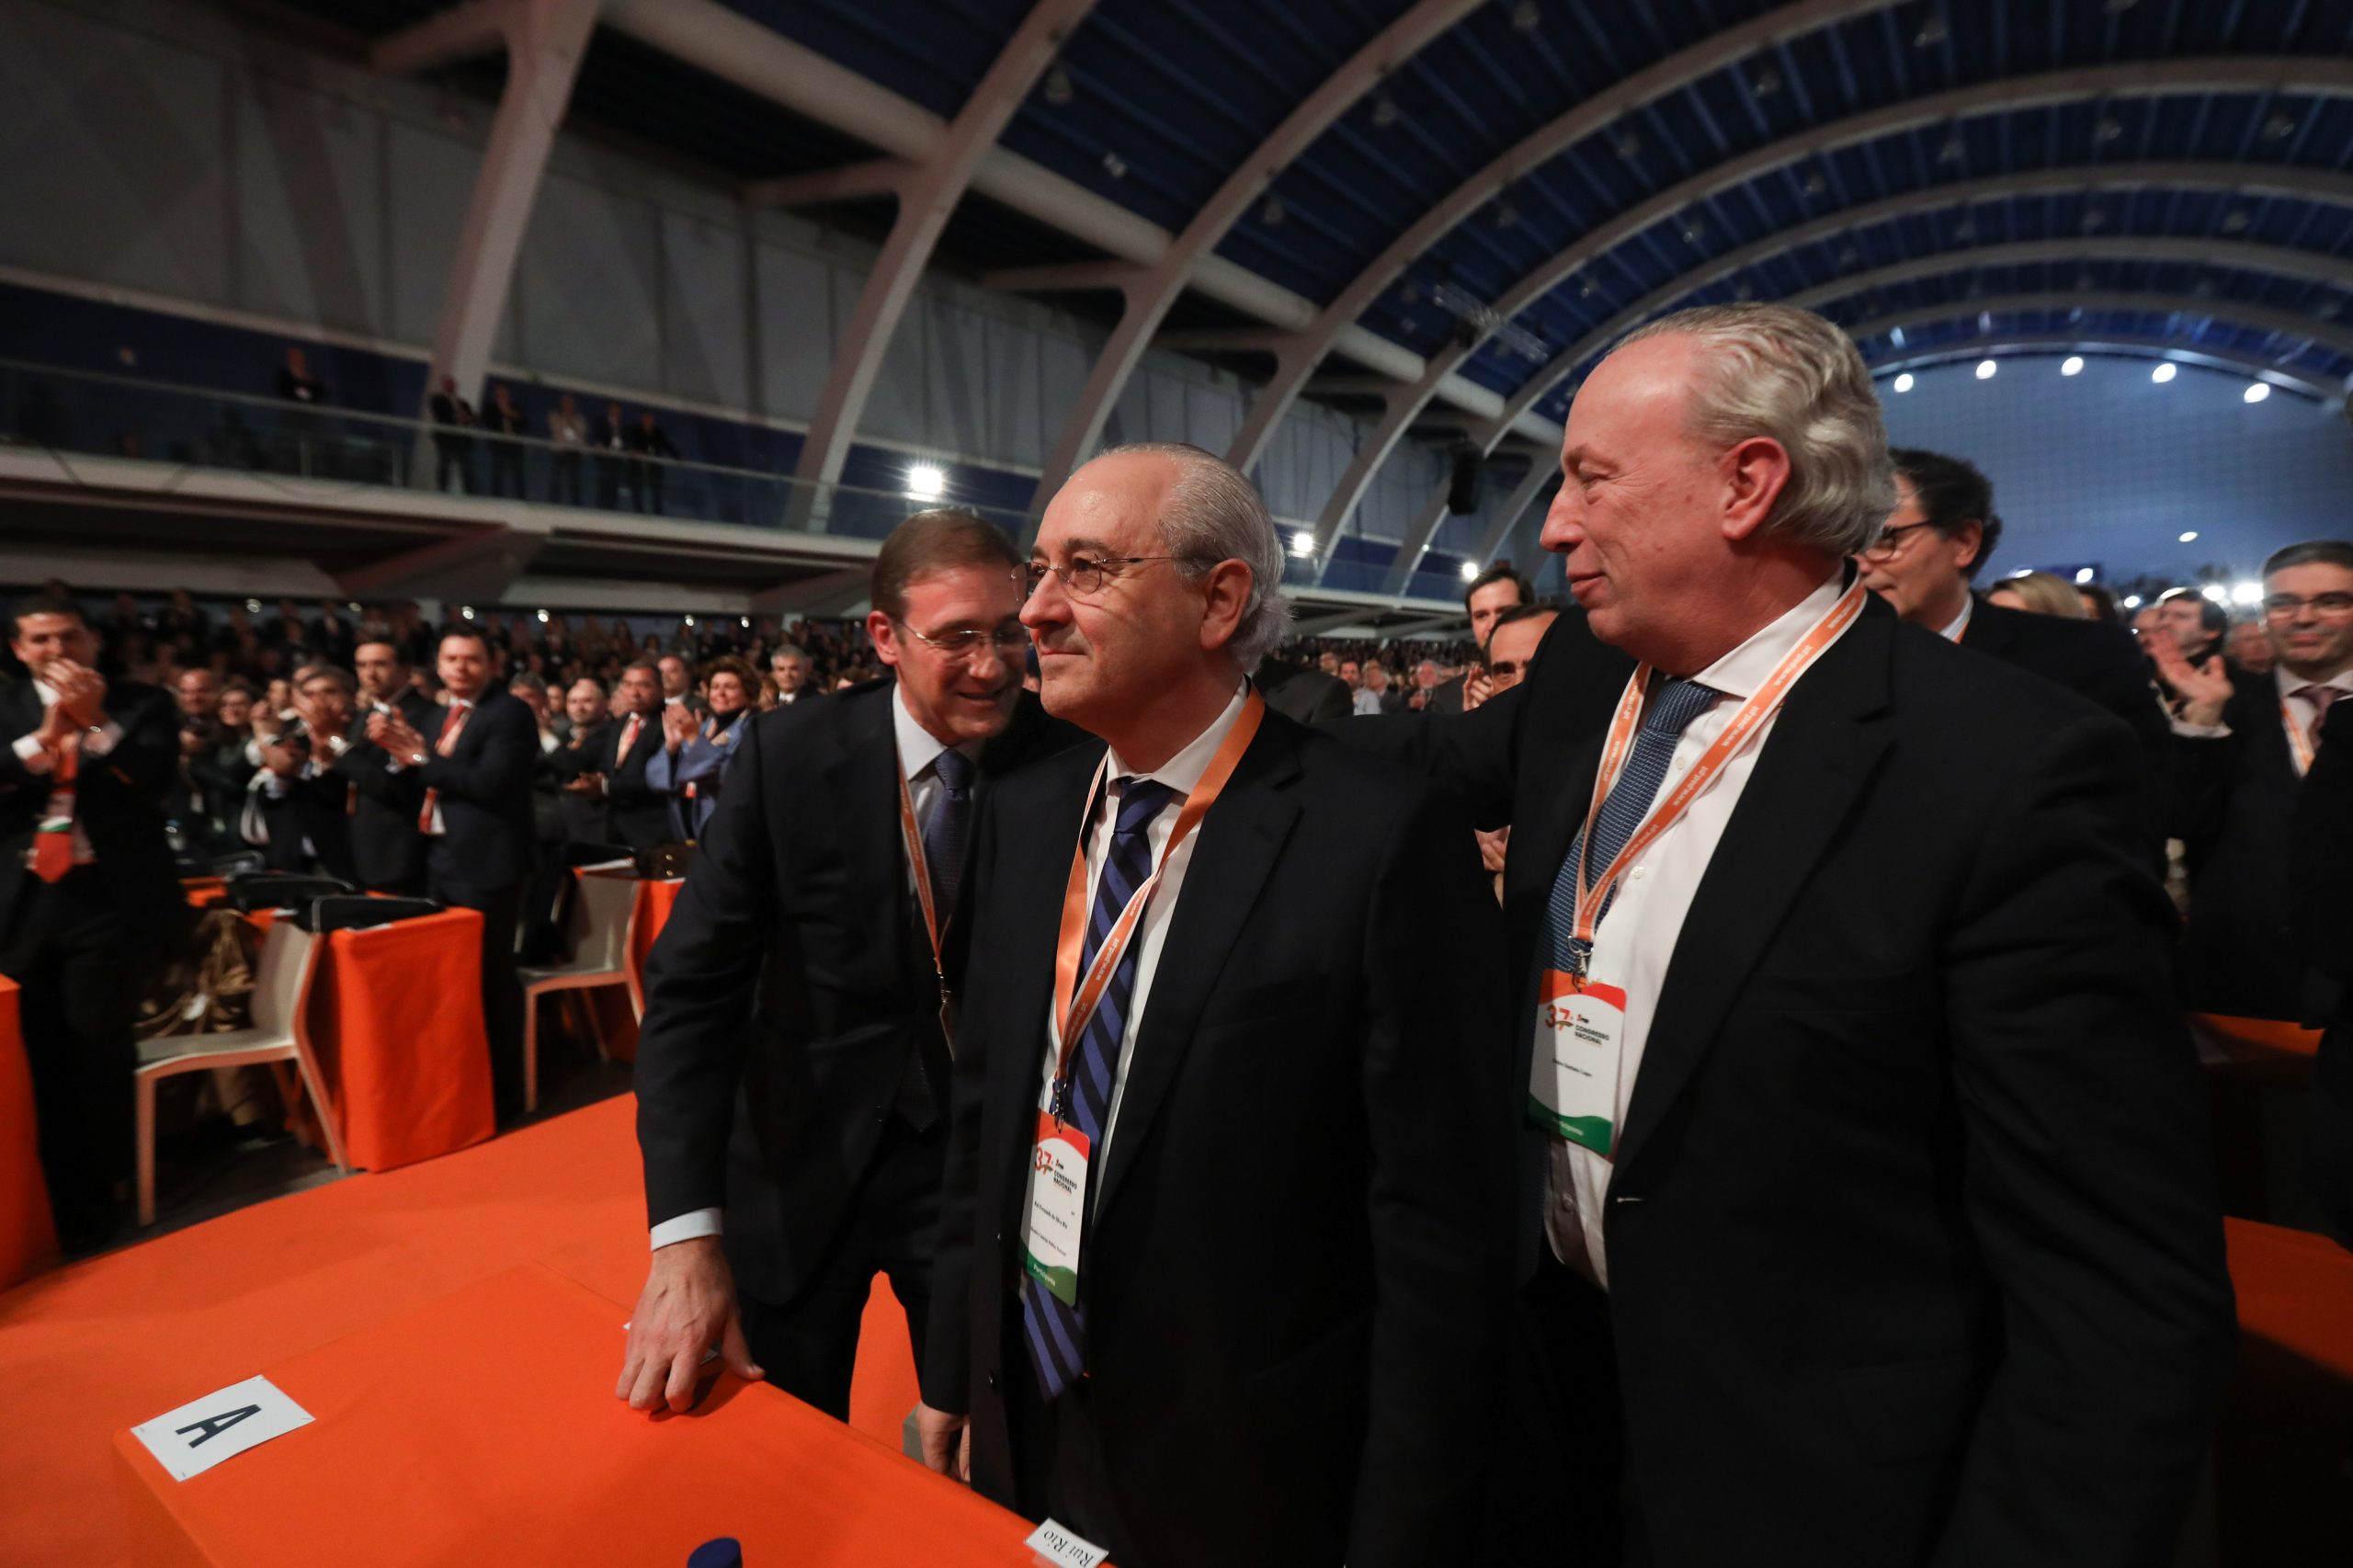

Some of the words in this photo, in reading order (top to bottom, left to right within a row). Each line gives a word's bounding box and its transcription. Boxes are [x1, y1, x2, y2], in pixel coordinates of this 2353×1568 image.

[1722, 705, 1760, 747] www.psd.pt
[1672, 766, 1709, 807] www.psd.pt
[1096, 937, 1120, 982] www.psd.pt
[175, 1403, 262, 1449] A
[1043, 1530, 1068, 1552] Rio
[1064, 1545, 1094, 1568] Rui
